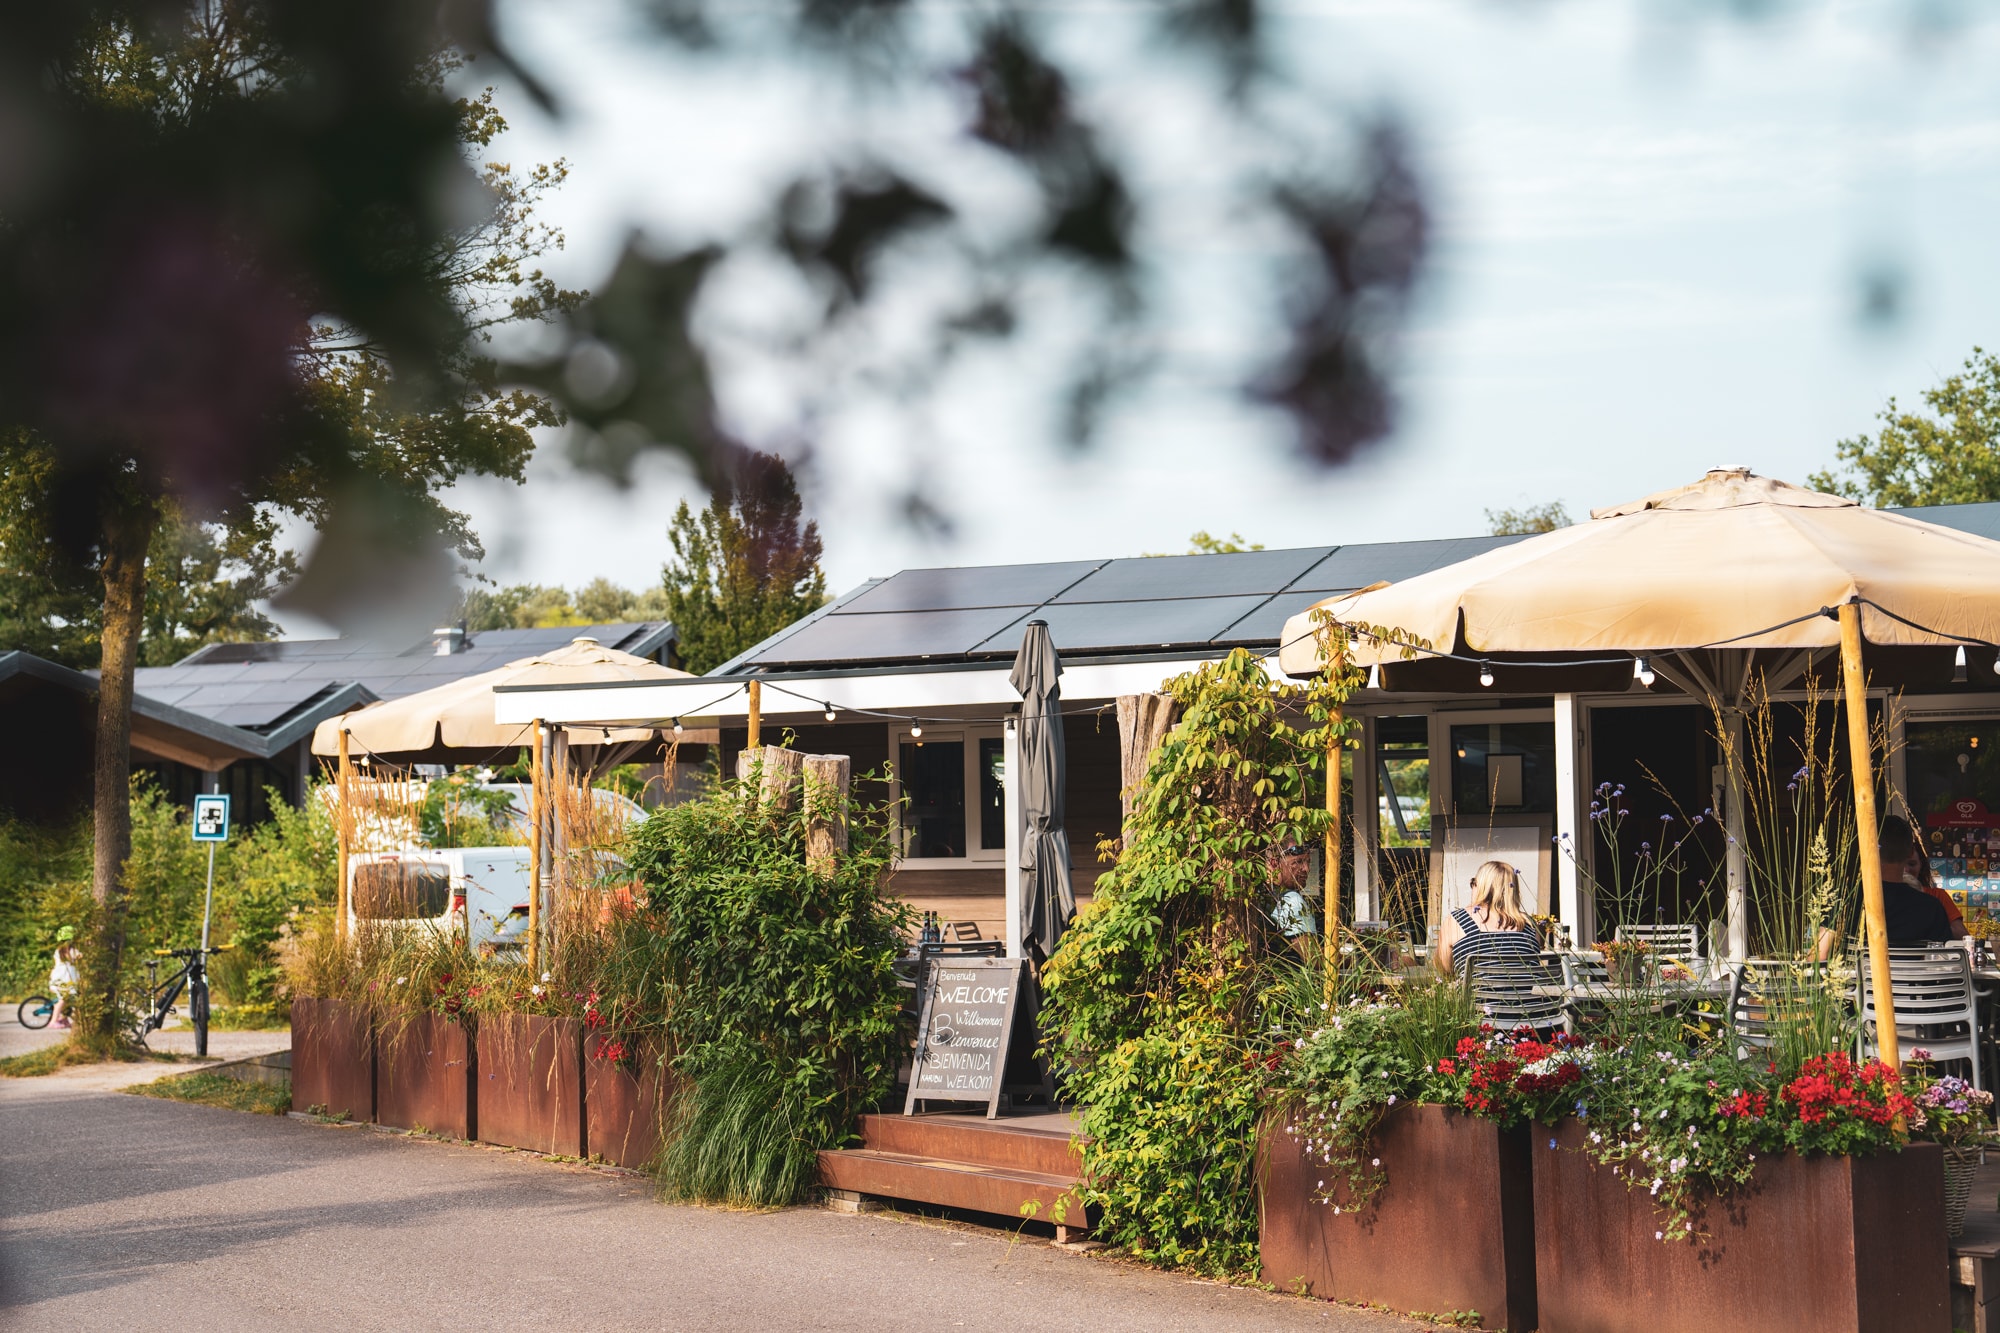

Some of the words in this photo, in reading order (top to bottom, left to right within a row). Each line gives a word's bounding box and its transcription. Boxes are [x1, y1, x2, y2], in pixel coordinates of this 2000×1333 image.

[940, 970, 976, 981] Benvenuta
[939, 986, 1009, 1004] WELCOME
[955, 1010, 1003, 1026] Willkommen
[930, 1013, 999, 1048] Bienvenue
[930, 1053, 991, 1071] BIENVENIDA
